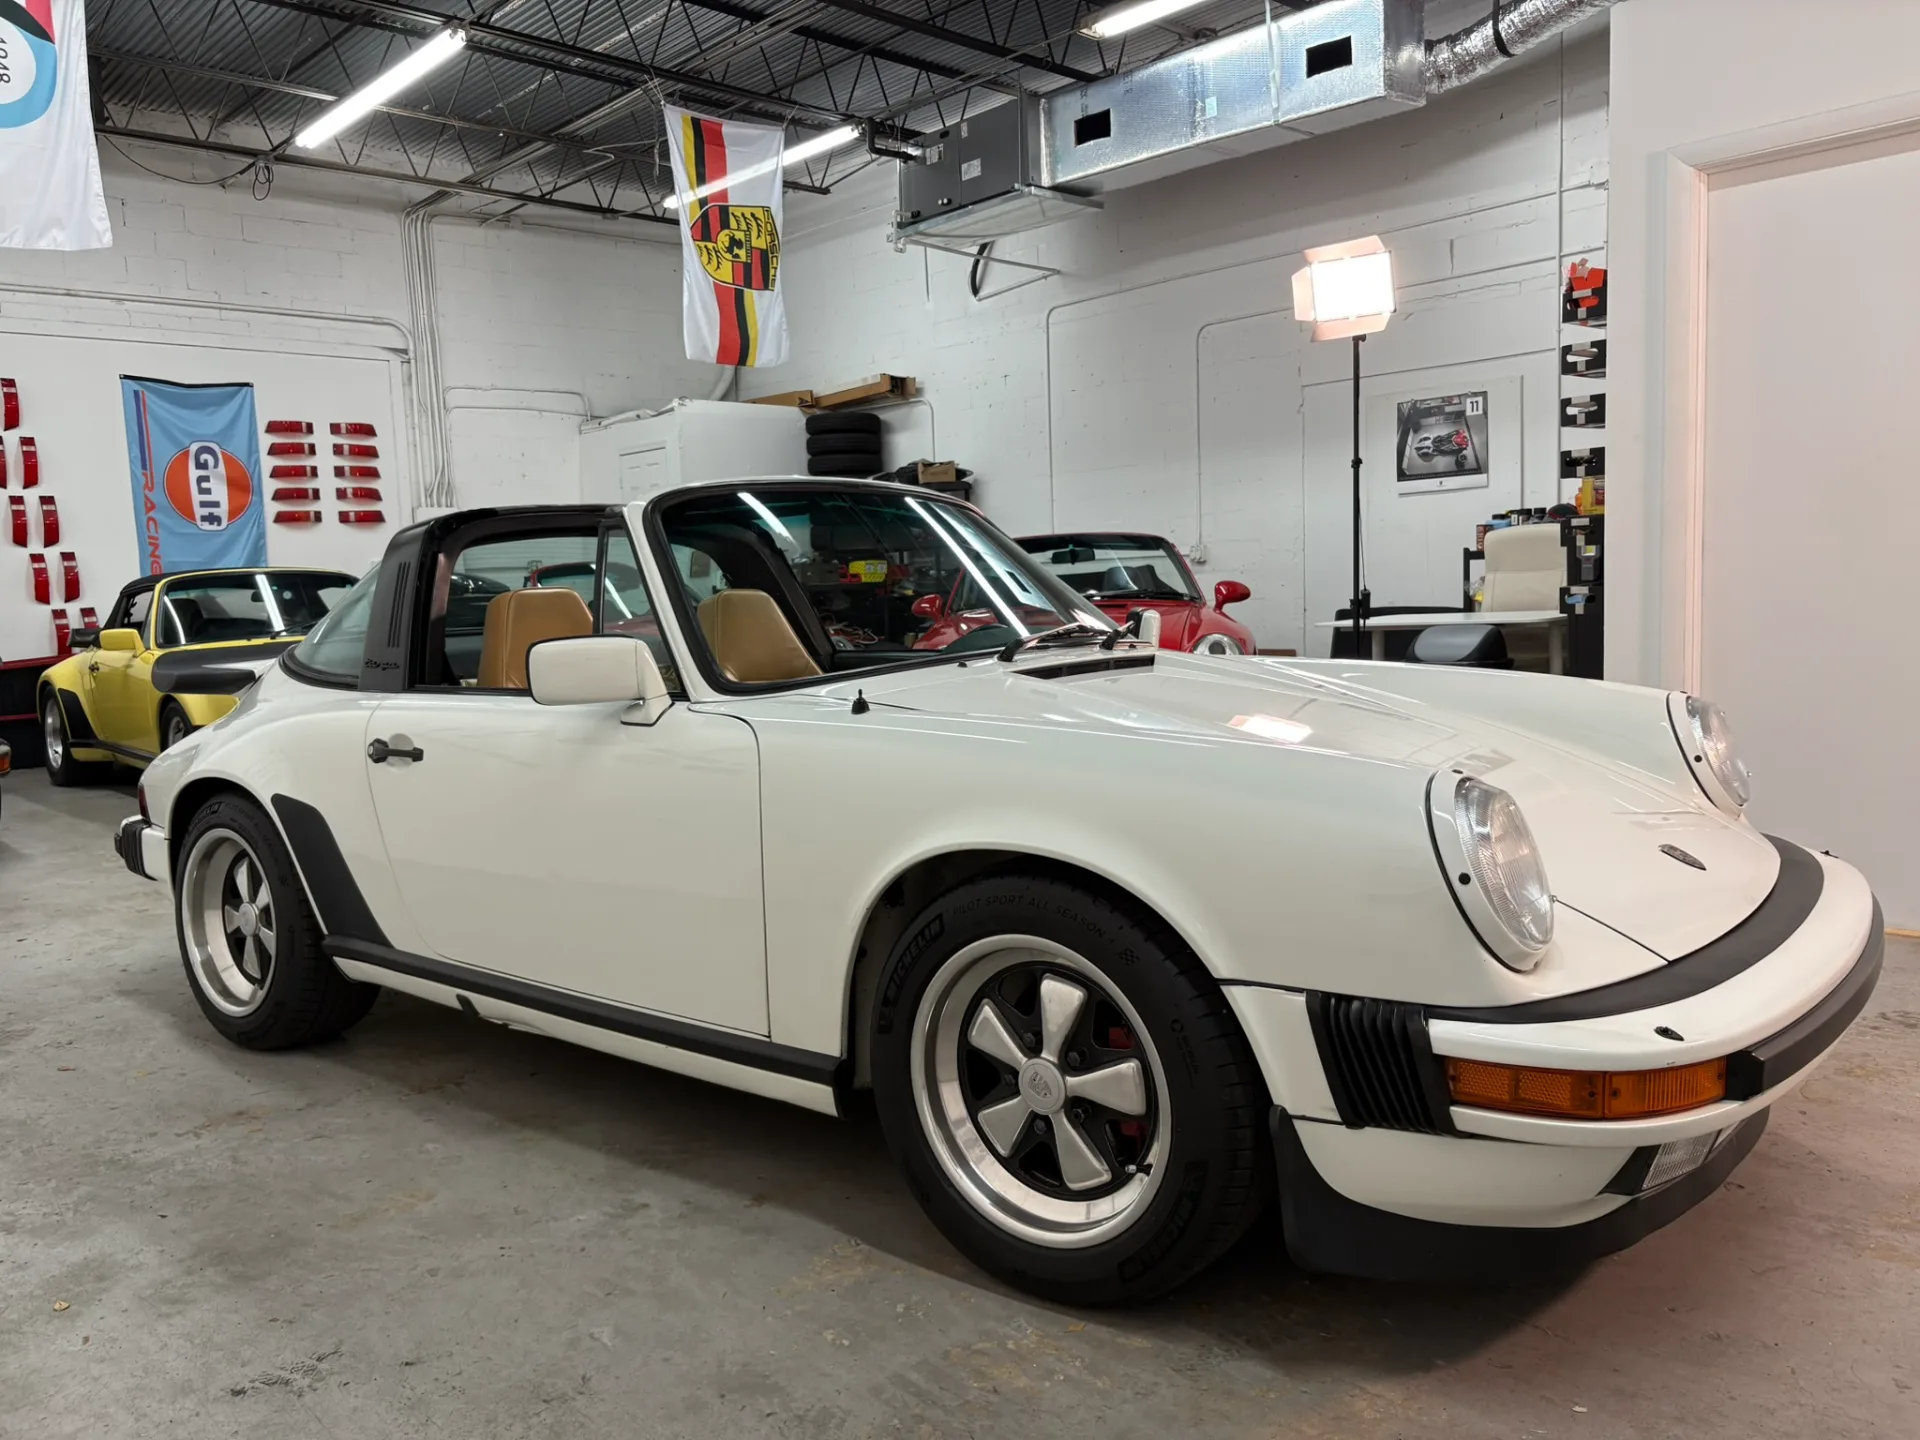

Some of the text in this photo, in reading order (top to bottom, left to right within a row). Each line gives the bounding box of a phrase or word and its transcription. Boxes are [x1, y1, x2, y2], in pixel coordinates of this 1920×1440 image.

[1470, 400, 1479, 413] 11
[142, 470, 164, 576] RACING
[194, 445, 223, 527] Gulf
[952, 897, 982, 915] PILOT
[985, 894, 1025, 907] SPORT
[1026, 897, 1049, 911] ALL
[1053, 904, 1107, 939] SEASON
[886, 917, 942, 1003] MICHELIN
